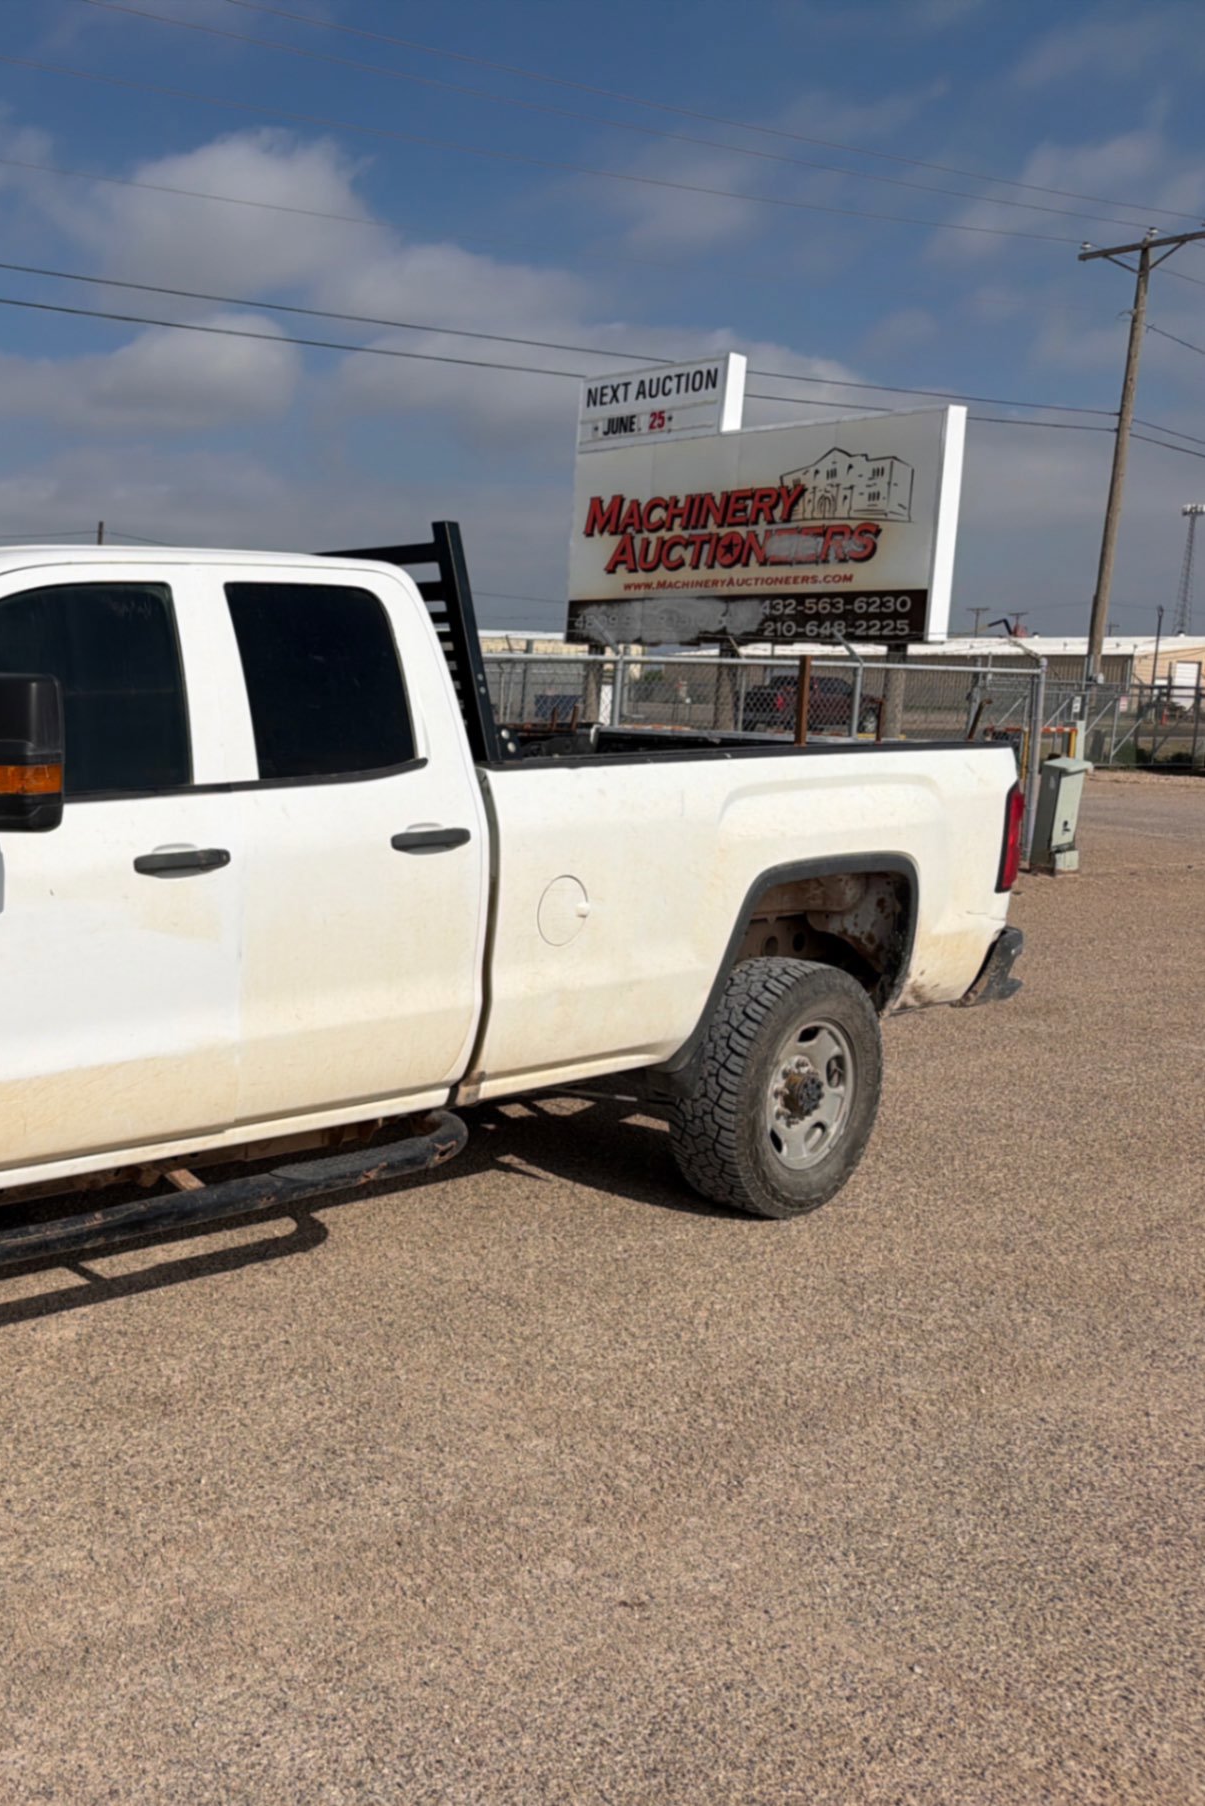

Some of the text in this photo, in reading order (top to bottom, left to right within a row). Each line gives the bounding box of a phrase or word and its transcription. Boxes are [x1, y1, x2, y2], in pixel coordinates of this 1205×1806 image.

[586, 367, 719, 408] NEXT AUCTION
[602, 410, 666, 436] JUNE 25
[584, 484, 806, 538] MACHINERY
[761, 596, 912, 615] 432-563-6230
[763, 619, 910, 637] 210-648-2225
